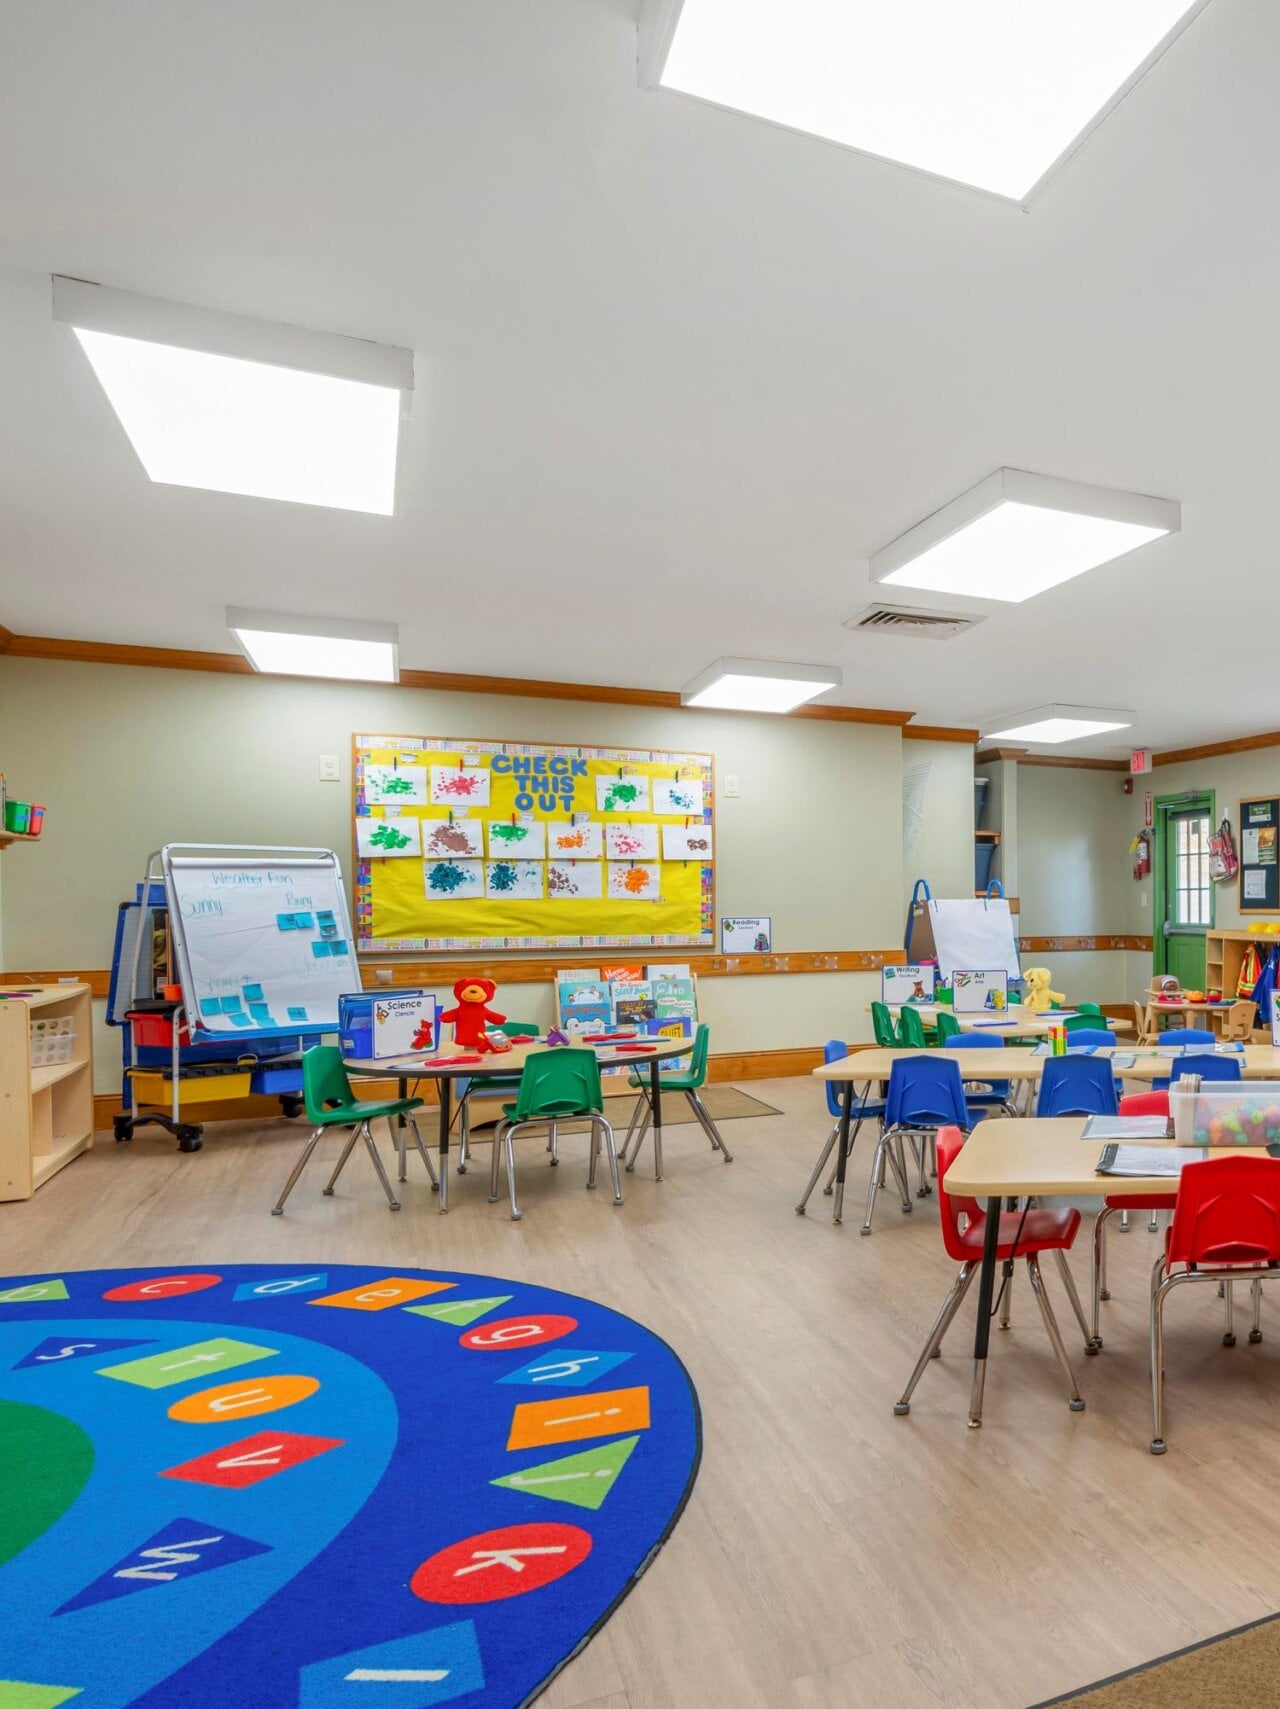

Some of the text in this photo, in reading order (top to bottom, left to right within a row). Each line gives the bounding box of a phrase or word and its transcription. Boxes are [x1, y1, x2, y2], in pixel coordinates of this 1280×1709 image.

[490, 754, 588, 777] CHECK
[514, 775, 575, 794] THIS
[514, 793, 575, 812] OUT
[212, 872, 294, 885] Weather Fun
[179, 894, 223, 915] Sunny
[896, 966, 920, 974] Writing
[387, 1000, 422, 1010] Science
[253, 1277, 320, 1293] d
[354, 1288, 402, 1302] e
[471, 1324, 544, 1345] g
[159, 1352, 227, 1372] t
[528, 1356, 600, 1383] h
[208, 1388, 274, 1413] u
[543, 1407, 622, 1427] i
[510, 1469, 613, 1486] j
